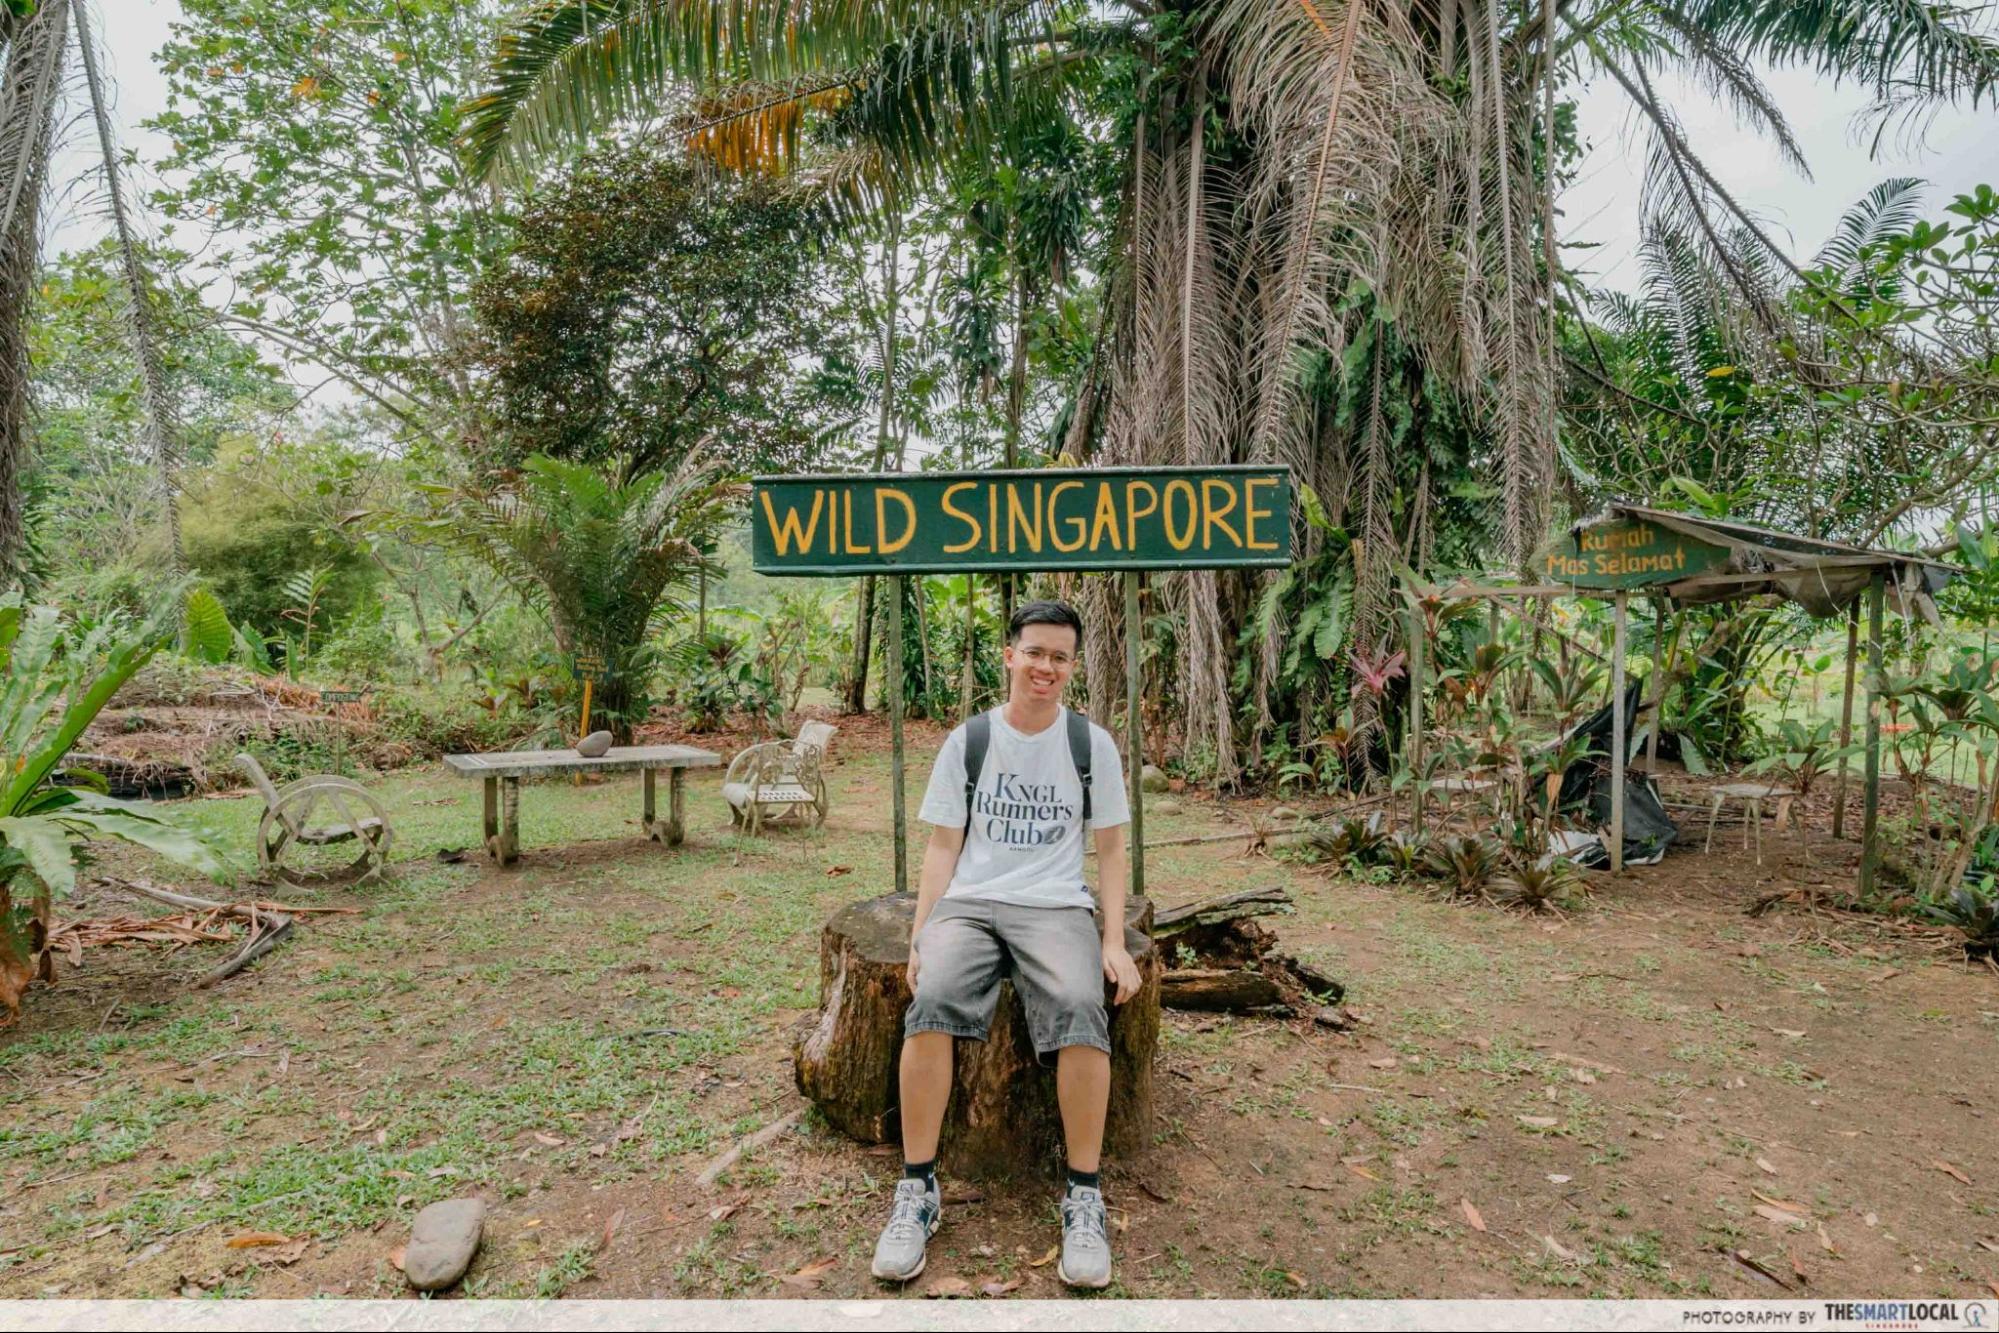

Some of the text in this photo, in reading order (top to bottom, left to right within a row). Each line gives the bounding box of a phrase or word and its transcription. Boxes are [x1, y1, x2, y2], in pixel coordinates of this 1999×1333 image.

[759, 479, 1280, 556] WILD SINGAPORE
[1547, 553, 1590, 575] Mas
[976, 791, 1074, 821] Runners
[986, 818, 1043, 845] Club
